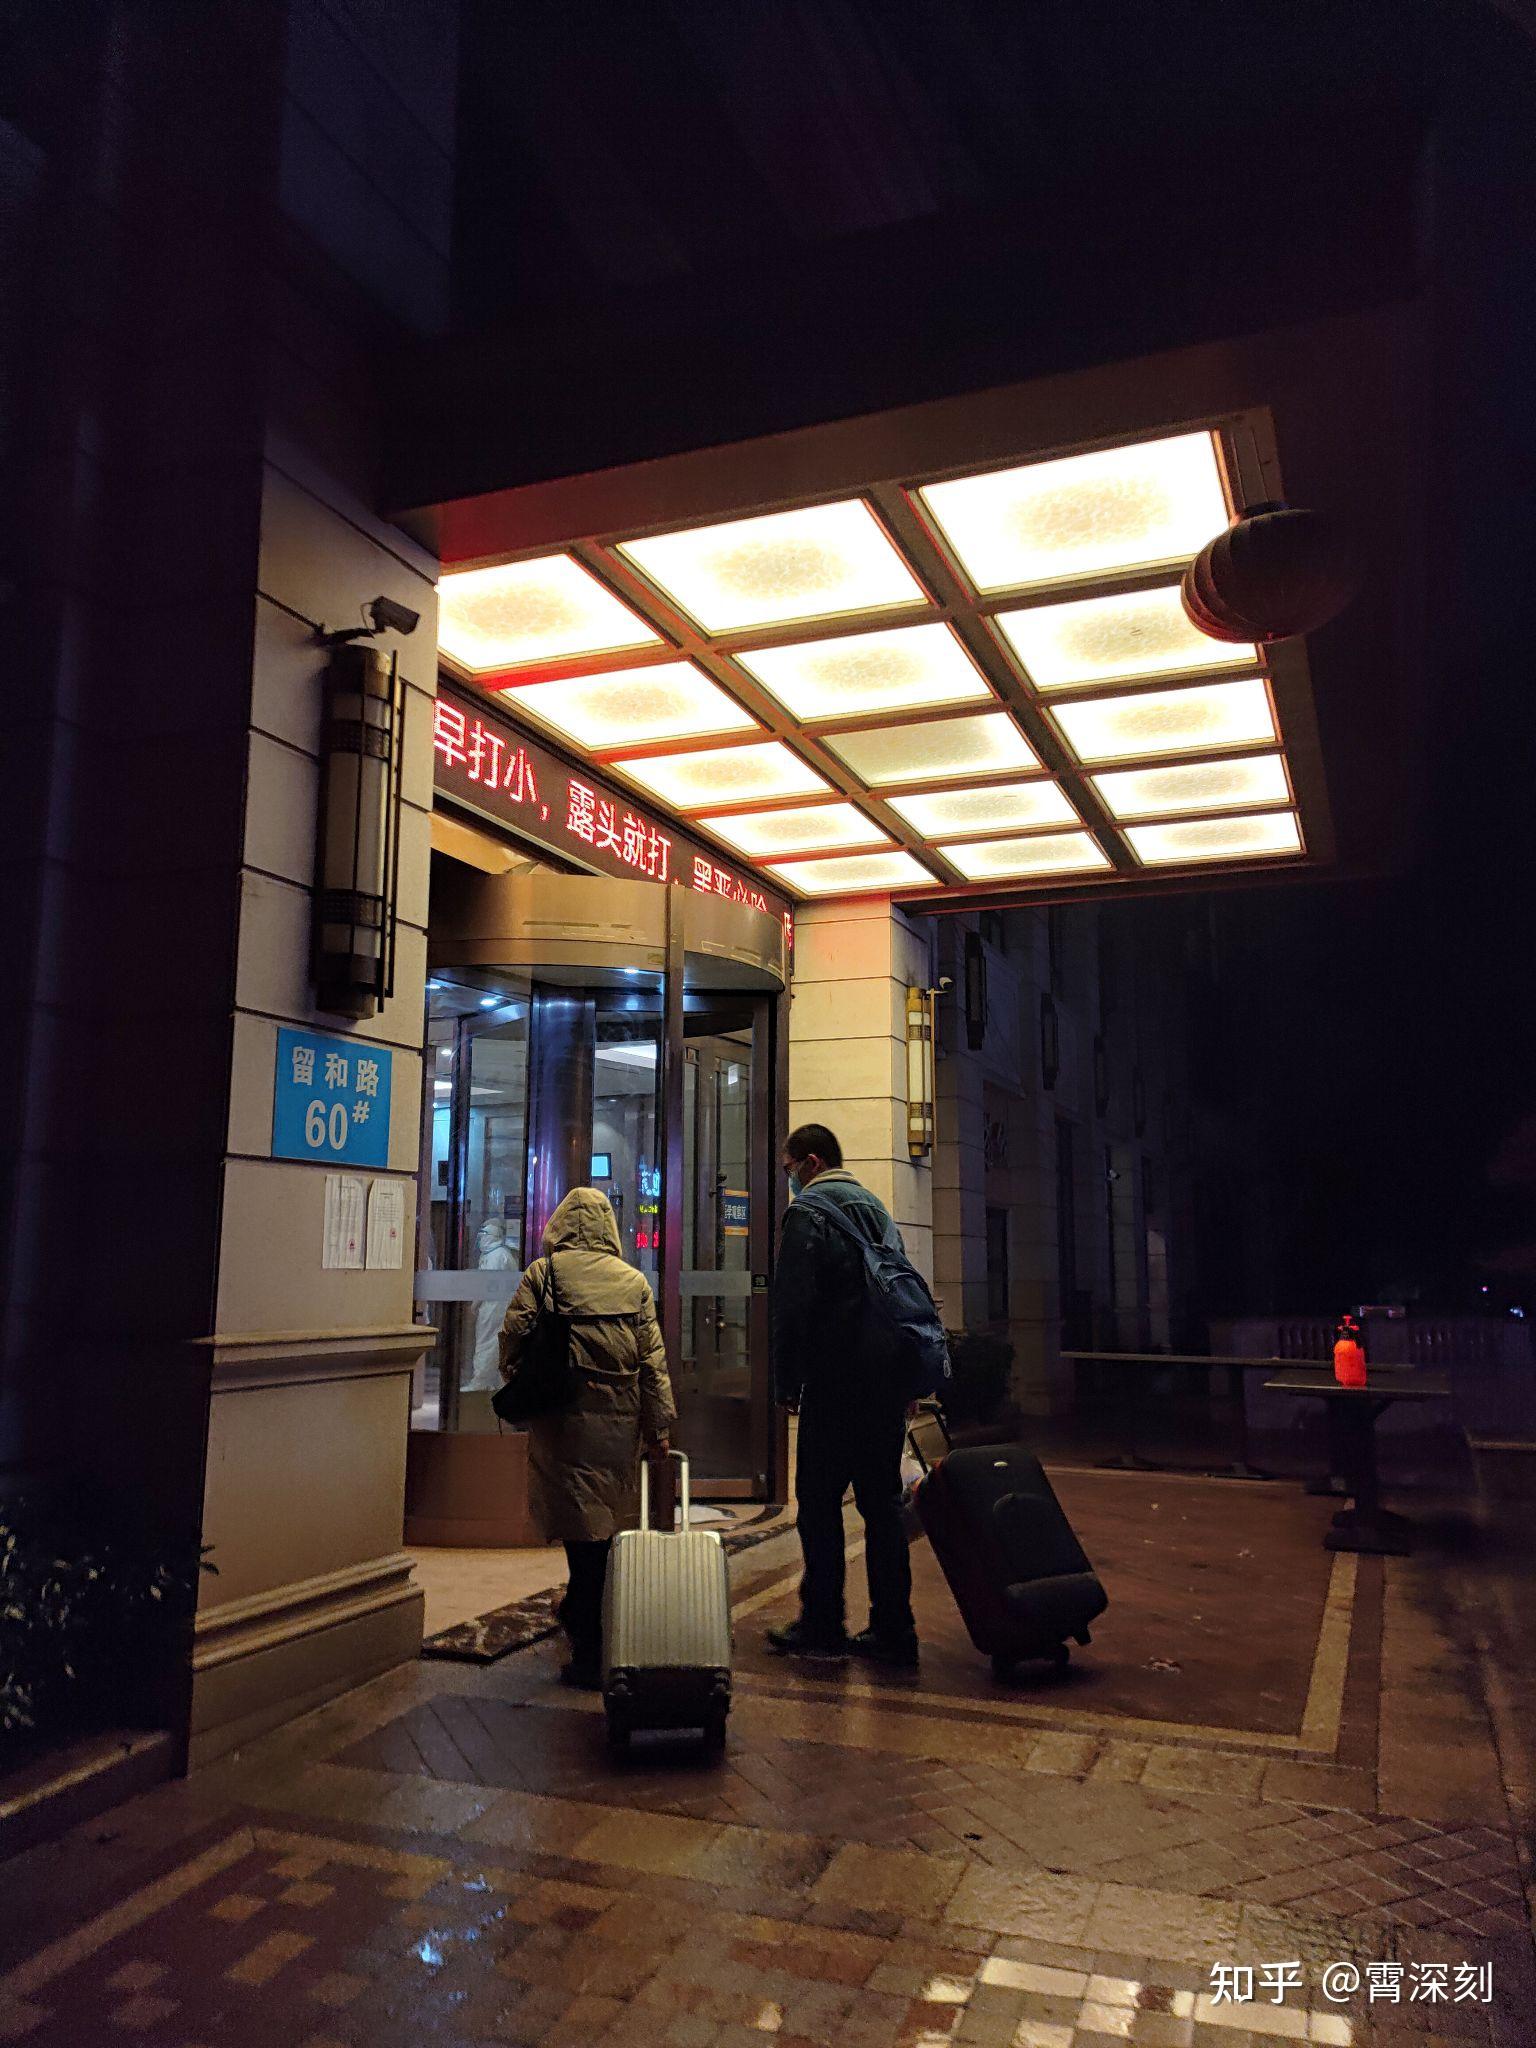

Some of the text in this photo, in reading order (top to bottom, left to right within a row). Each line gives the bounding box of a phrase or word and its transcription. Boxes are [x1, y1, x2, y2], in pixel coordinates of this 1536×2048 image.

[292, 1046, 380, 1097] 留和路
[305, 1100, 370, 1150] 60#
